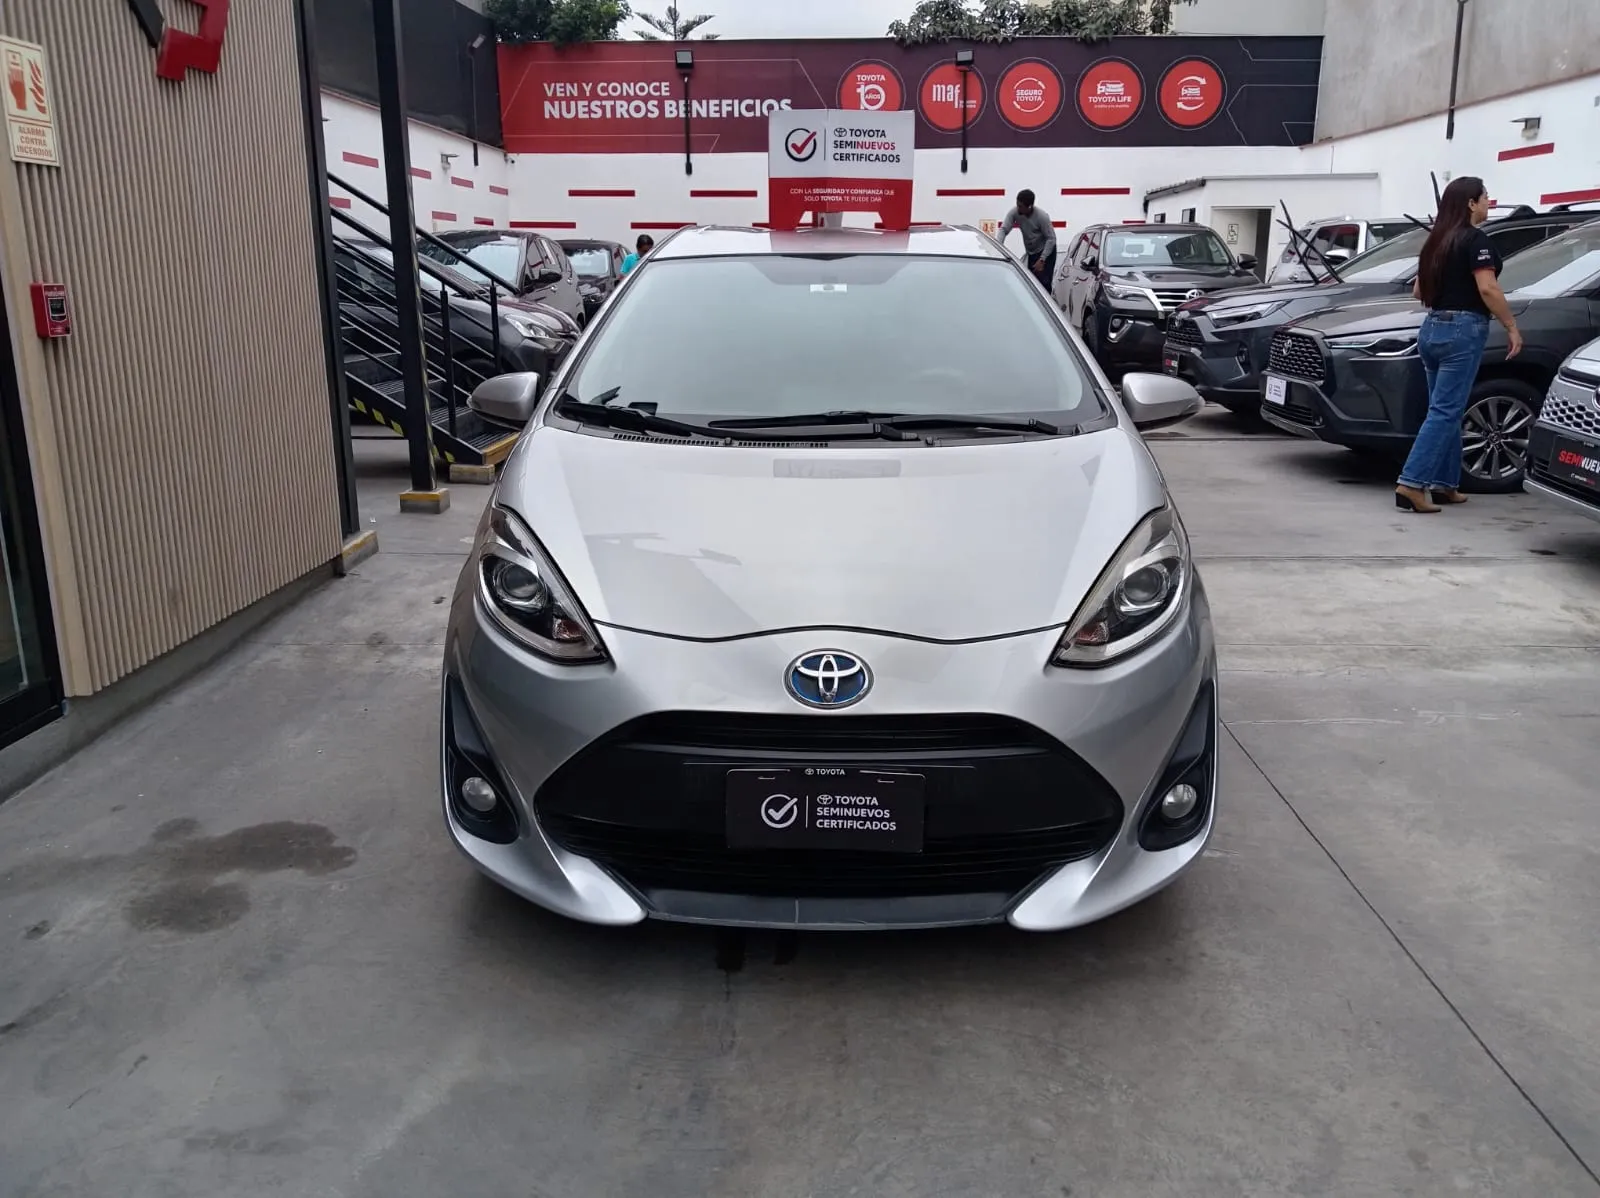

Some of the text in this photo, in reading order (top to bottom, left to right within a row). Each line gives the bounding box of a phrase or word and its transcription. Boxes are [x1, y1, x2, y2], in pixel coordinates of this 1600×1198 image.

[856, 74, 886, 82] TOYOTA
[543, 82, 670, 97] VEN Y CONOCE
[932, 84, 961, 109] maf
[543, 98, 792, 119] NUESTROS BENEFICIOS
[19, 126, 46, 137] ALARMA
[849, 128, 887, 138] TOYOTA
[20, 136, 47, 147] CONTRA
[833, 140, 896, 151] SEMINUEVOS
[833, 152, 901, 163] CERTIFICADOS
[835, 795, 878, 805] TOYOTA
[816, 807, 890, 818] SEMINUEVOS
[816, 819, 897, 831] CERTIFICADOS
